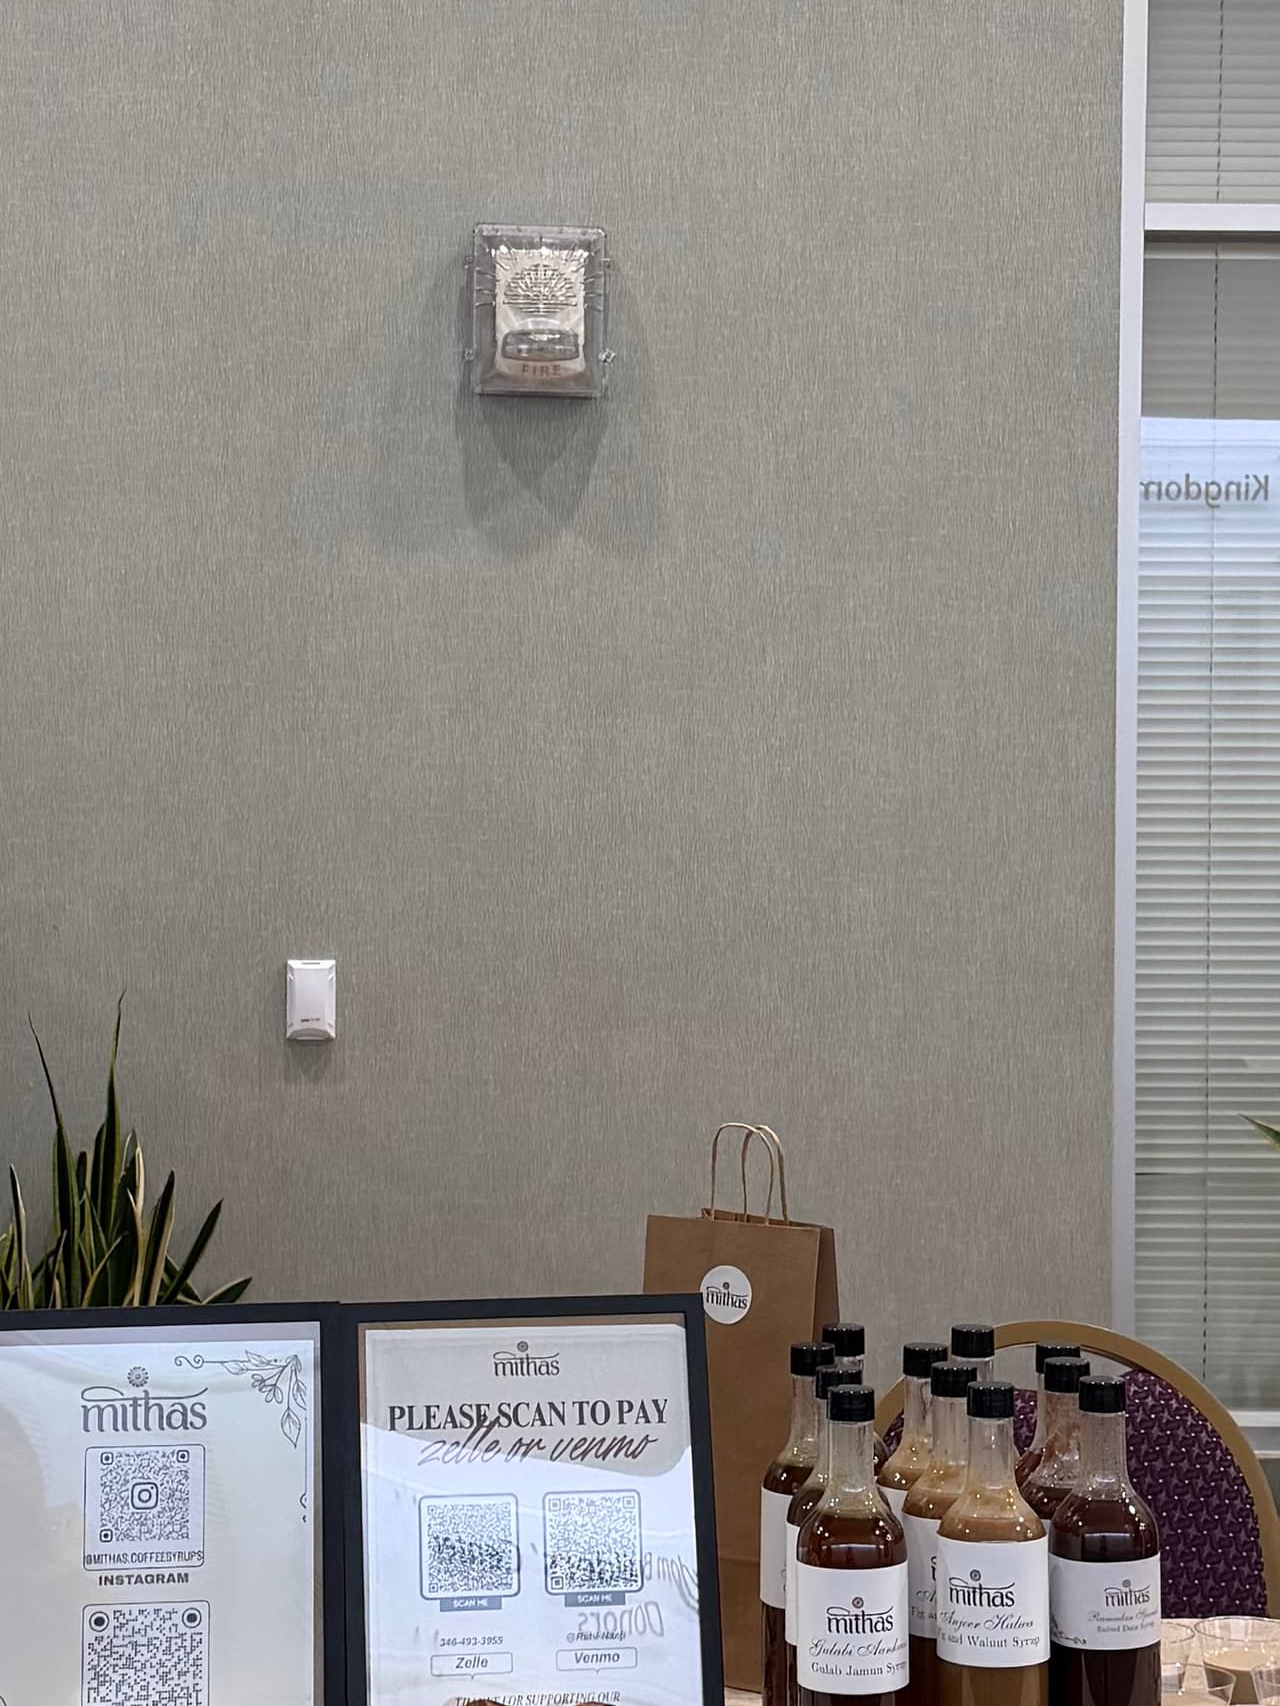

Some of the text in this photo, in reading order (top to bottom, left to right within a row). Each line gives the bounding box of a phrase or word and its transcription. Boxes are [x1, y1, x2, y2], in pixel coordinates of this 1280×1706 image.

[521, 364, 563, 377] FIRE
[492, 1351, 561, 1378] mithas
[80, 1387, 209, 1433] mithas
[387, 1398, 669, 1432] PLEASE SCAN TO PAY
[417, 1414, 658, 1467] zelle or venmo
[98, 1573, 190, 1587] INSTAGRAM
[576, 1594, 601, 1603] SCAN
[948, 1577, 1017, 1608] mithas
[452, 1599, 476, 1608] SCAN
[826, 1605, 894, 1635] mithas
[967, 1635, 1008, 1648] Walnut
[455, 1656, 489, 1669] Zelle
[573, 1652, 621, 1664] Venmo
[811, 1661, 843, 1676] Gulab
[845, 1664, 884, 1677] Jamun
[526, 1692, 596, 1706] SUPPORTING
[597, 1690, 621, 1702] OUR
